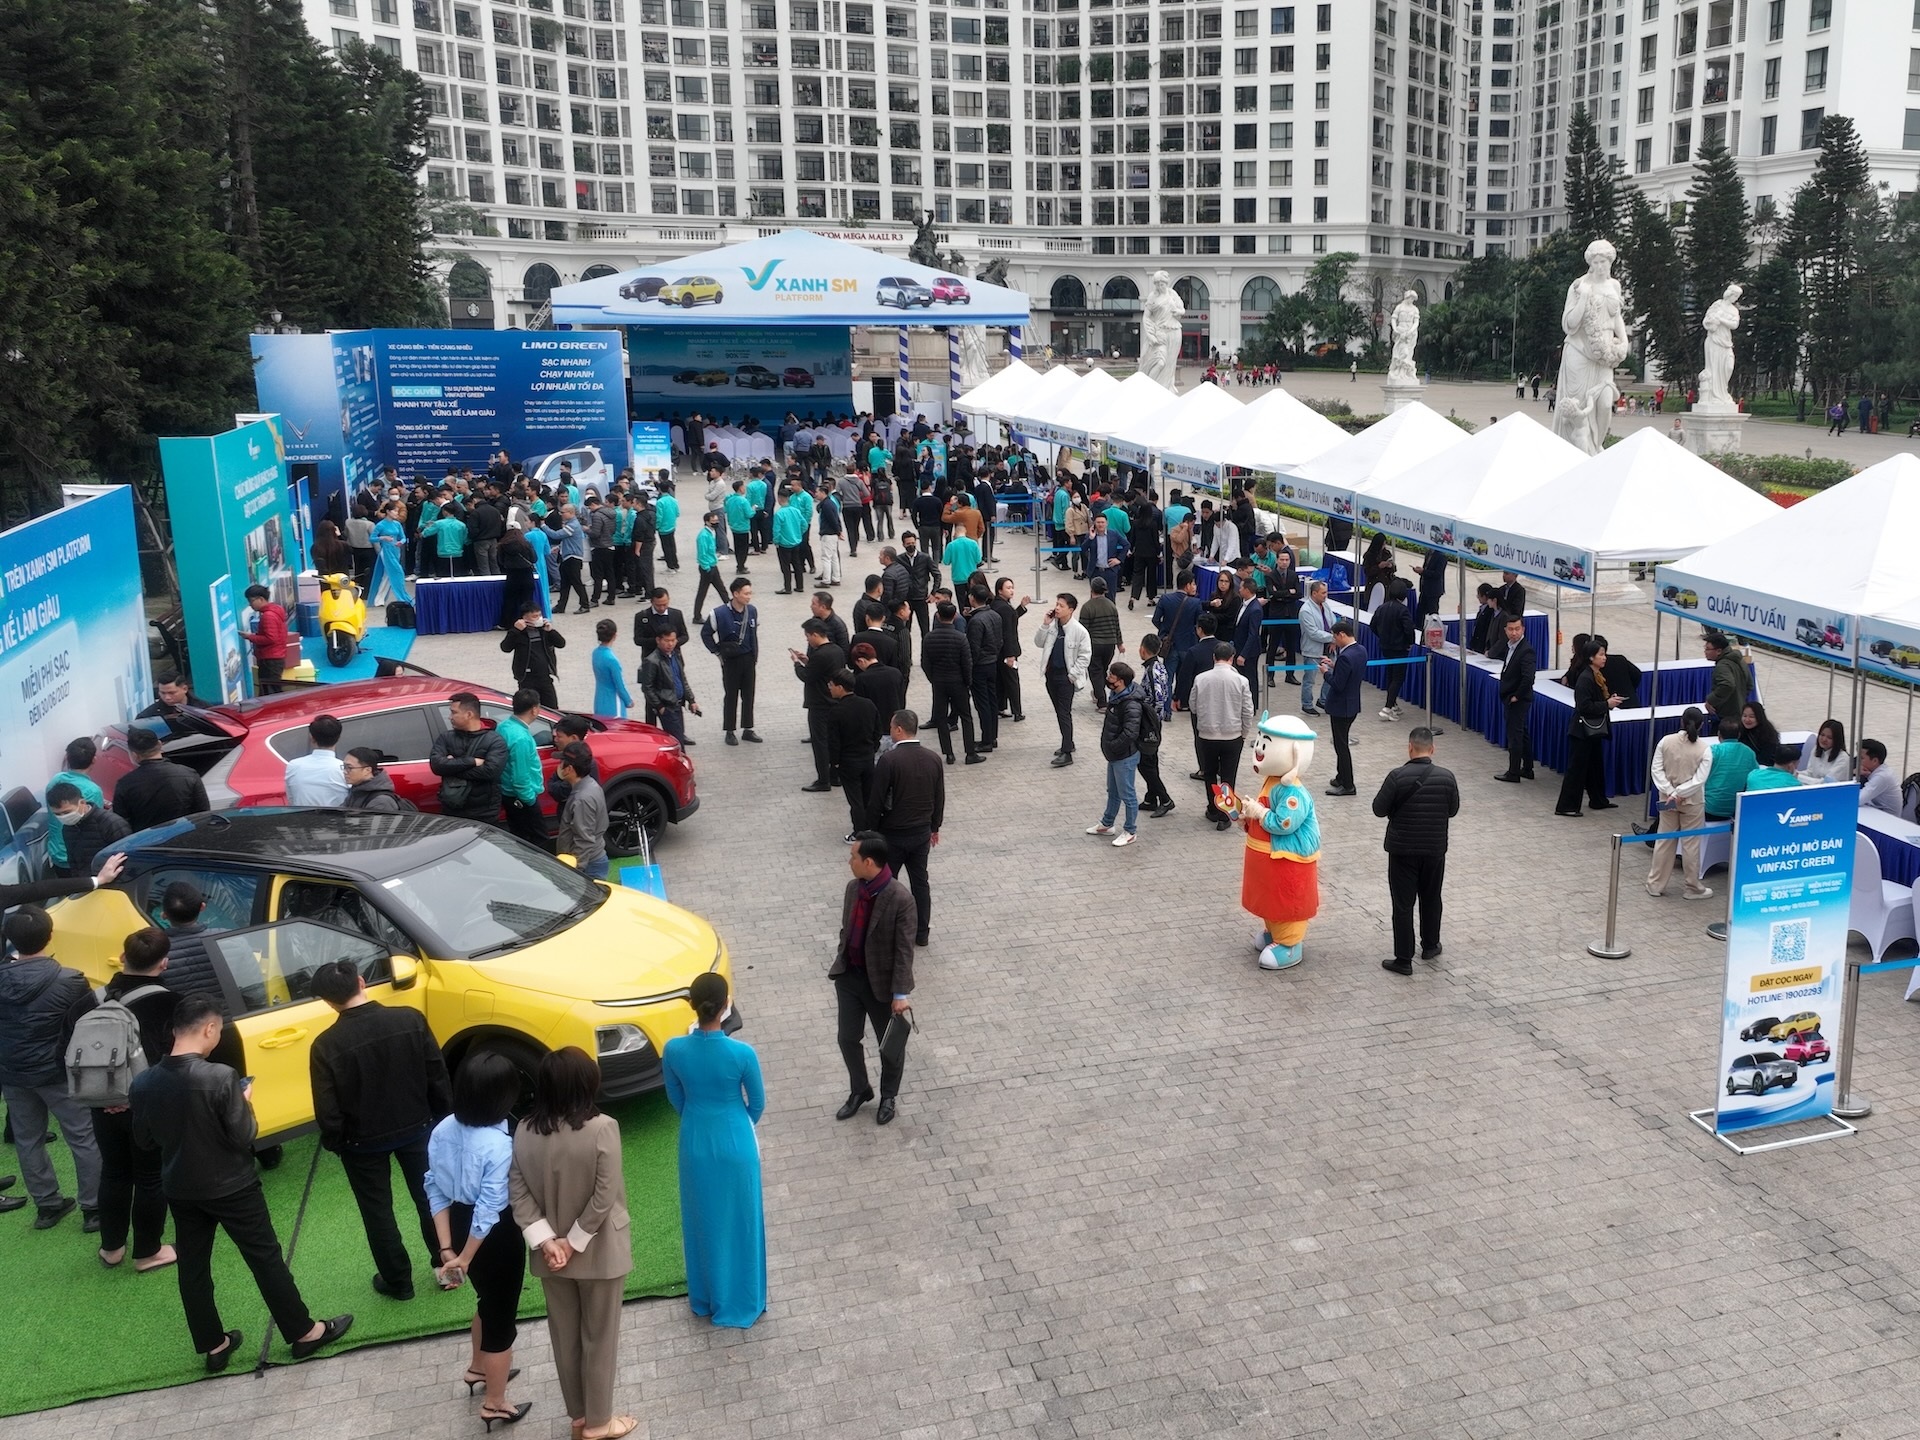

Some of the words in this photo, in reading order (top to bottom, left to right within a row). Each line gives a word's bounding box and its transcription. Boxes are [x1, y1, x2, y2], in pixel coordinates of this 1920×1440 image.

[868, 233, 890, 241] MALL
[775, 278, 828, 292] XANH
[831, 278, 858, 293] SM
[522, 342, 558, 350] LIMO
[559, 342, 608, 350] GREEN
[541, 358, 559, 367] SẠC
[560, 358, 591, 366] NHANH
[540, 370, 563, 379] CHẠY
[563, 370, 594, 378] NHANH
[395, 388, 413, 396] ĐỘC
[414, 387, 440, 396] QUYỀN
[531, 382, 545, 391] LỢI
[545, 381, 576, 391] NHUẬN
[577, 381, 591, 391] TỐI
[592, 383, 604, 391] ĐA
[431, 409, 452, 417] VỮNG
[452, 408, 461, 416] KẾ
[462, 409, 478, 417] LÀM
[478, 409, 496, 417] GIÀU
[1298, 487, 1310, 501] QUẦY
[1311, 490, 1318, 503] TƯ
[1318, 491, 1330, 507] VẤN
[1385, 512, 1402, 528] QUẦY
[1402, 517, 1412, 531] TƯ
[1412, 517, 1425, 535] VẤN
[5, 563, 26, 593] TRÊN
[24, 555, 47, 583] XANH
[46, 549, 58, 572] SM
[57, 534, 91, 567] PLATFORM
[1494, 542, 1515, 560] QUẦY
[1516, 548, 1529, 563] TƯ
[1529, 550, 1547, 569] VẤN
[1707, 595, 1739, 617] QUẦY
[1741, 603, 1760, 622] TƯ
[1760, 607, 1786, 631] VẤN
[3, 609, 17, 650] KẾ
[16, 607, 38, 641] LÀM
[37, 593, 60, 628] GIÀU
[21, 664, 42, 703] MIỄN
[41, 654, 54, 688] PHÍ
[53, 650, 70, 678] SẠC
[29, 701, 42, 727] ĐẾN
[1789, 814, 1811, 824] XANH
[1811, 813, 1823, 821] SM
[1750, 845, 1780, 859] NGÀY
[1781, 842, 1800, 856] HỘI
[1802, 840, 1820, 852] MỞ
[1821, 838, 1843, 850] BÁN
[1756, 859, 1800, 874] VINFAST
[1801, 855, 1835, 868] GREEN
[1770, 890, 1790, 900] 90%
[1760, 978, 1775, 987] ĐẶT
[1775, 976, 1791, 985] CỌC
[1793, 973, 1814, 982] NGAY
[1747, 993, 1783, 1005] HOTLINE:
[1785, 987, 1822, 999] 19002293
